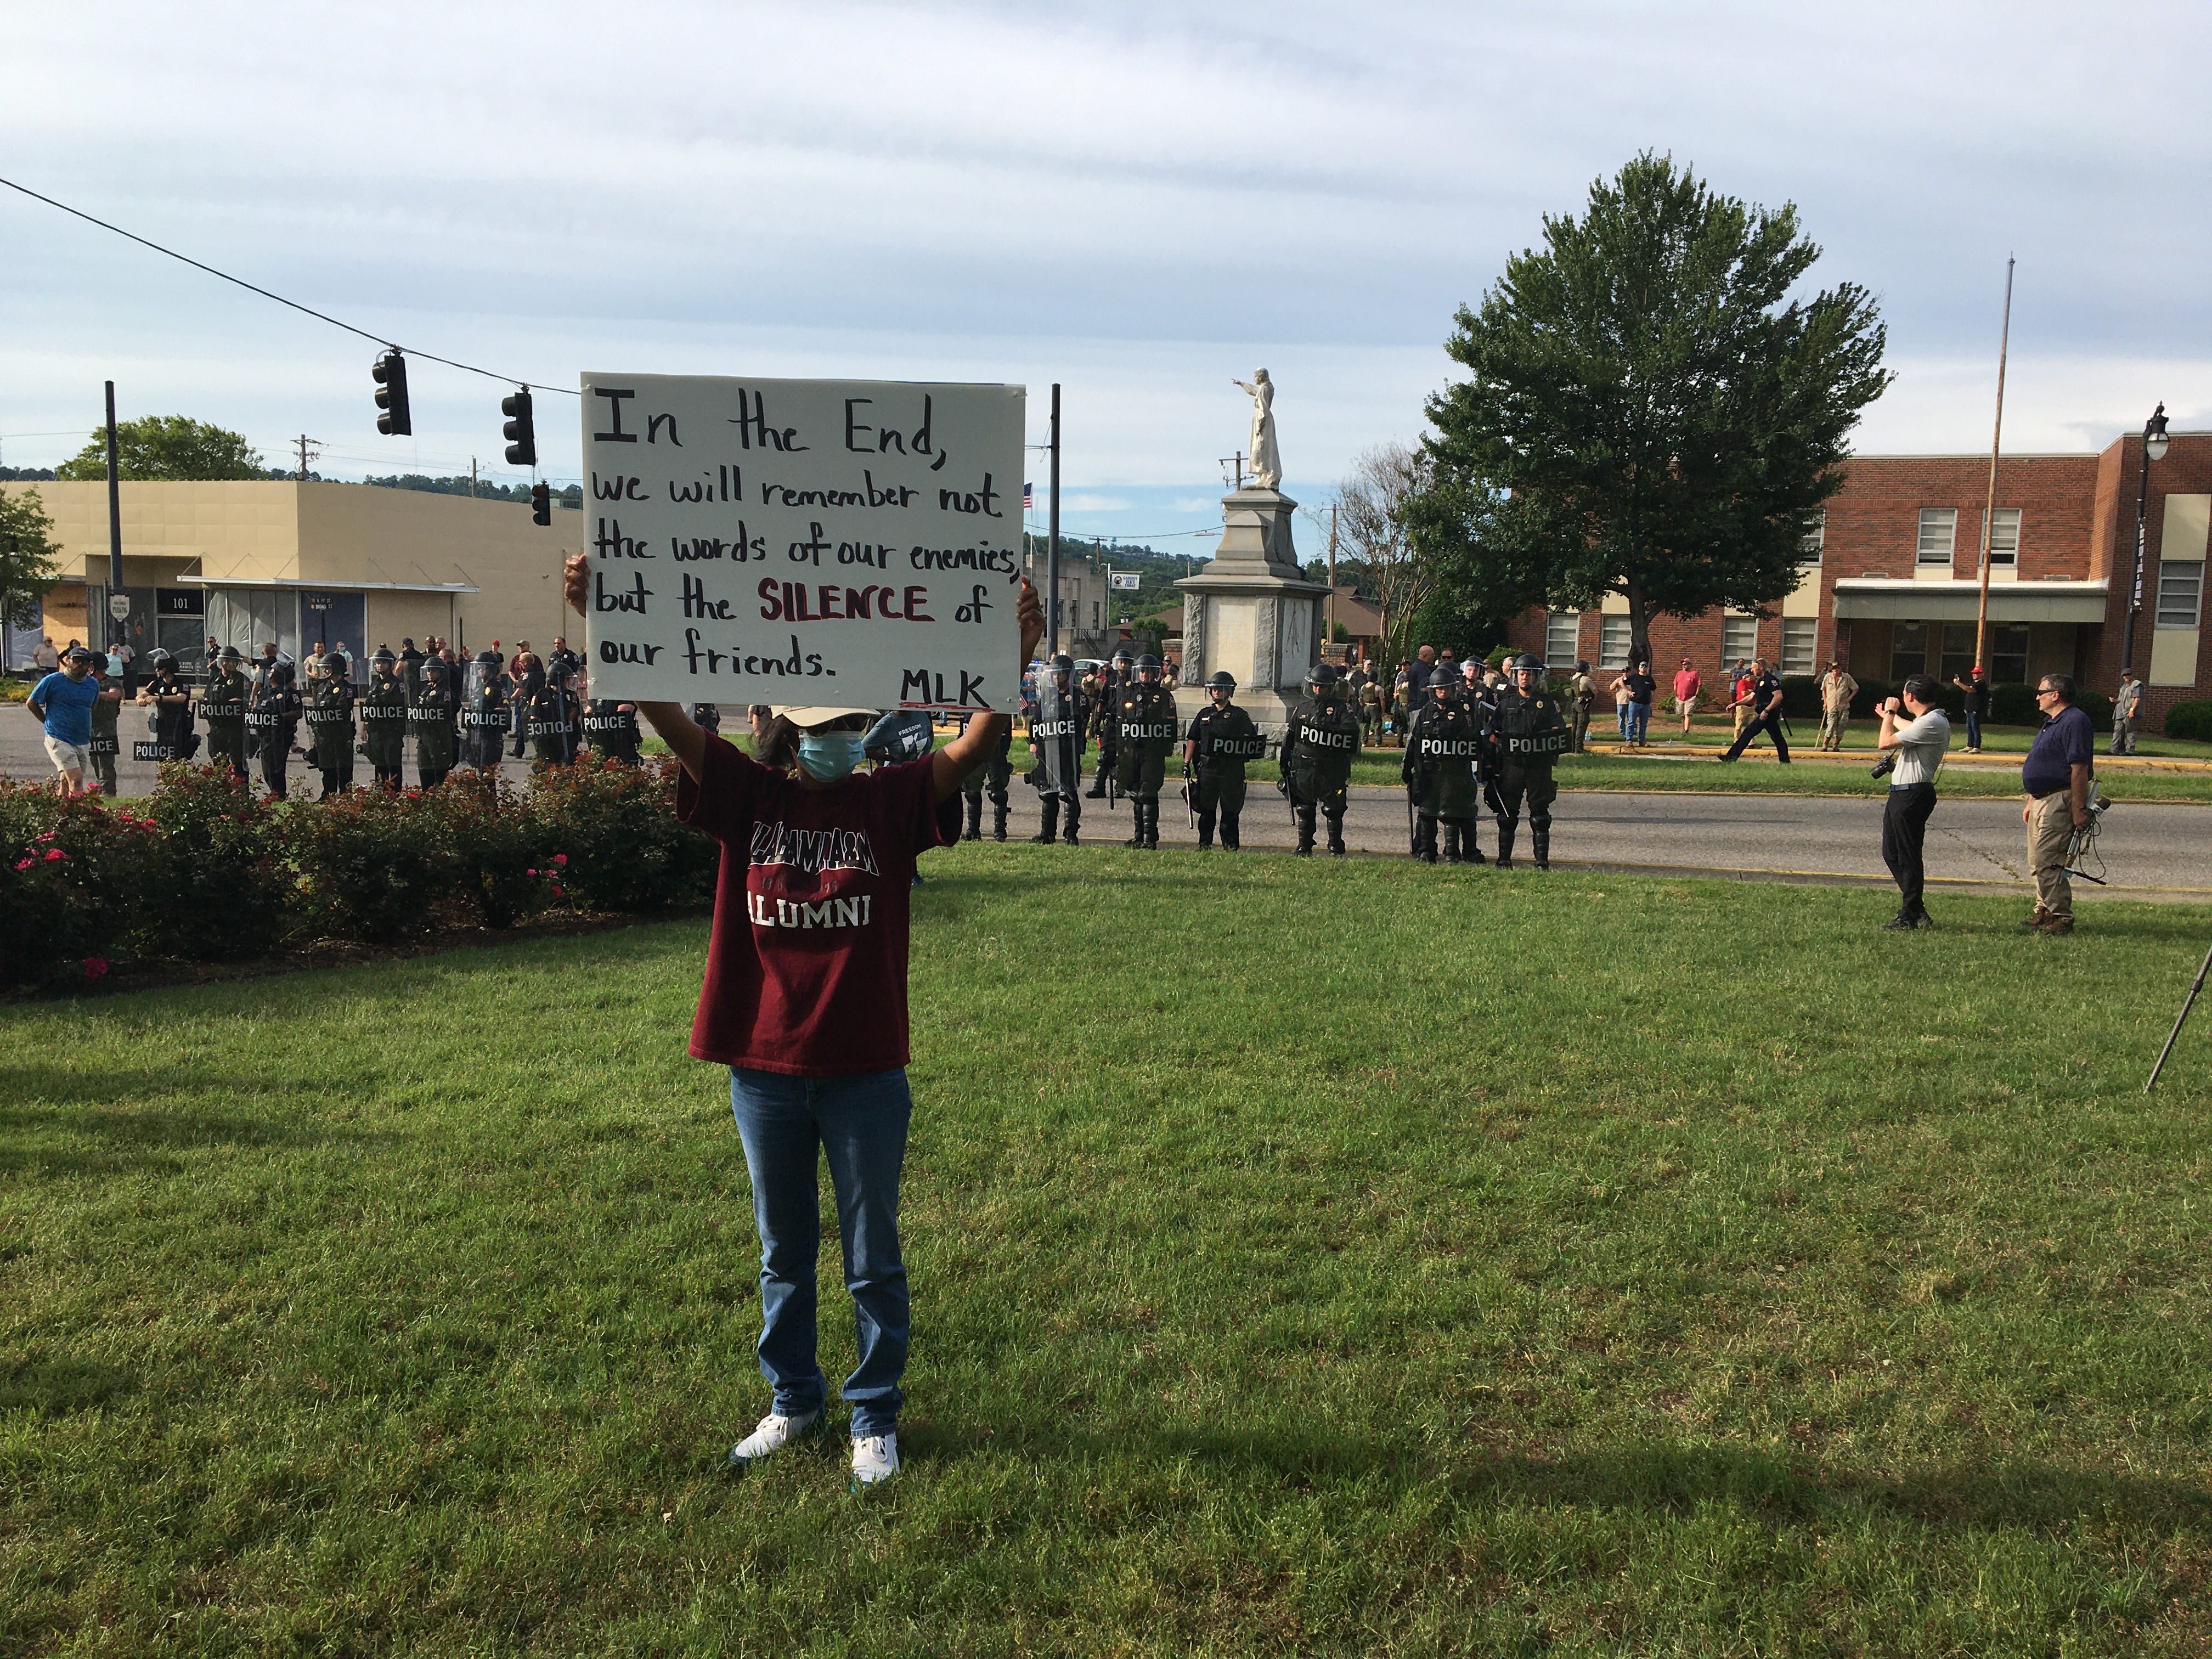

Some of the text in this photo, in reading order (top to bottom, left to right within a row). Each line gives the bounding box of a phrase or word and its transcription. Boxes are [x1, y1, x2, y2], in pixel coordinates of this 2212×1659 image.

[593, 387, 947, 472] In the End,
[592, 464, 1003, 518] we will remember not
[592, 517, 1020, 585] the words of our enemies,
[173, 597, 188, 609] 101
[595, 571, 994, 624] but the SILENCE of
[600, 628, 837, 676] our friends.
[898, 668, 989, 706] MLK
[200, 704, 241, 716] POLICE
[306, 709, 343, 721] POLICE
[363, 706, 404, 718] POLICE
[408, 708, 444, 720] POLICE
[245, 713, 278, 726] POLICE
[464, 712, 506, 726] POLICE
[584, 716, 626, 730] POLICE
[898, 723, 922, 736] FREEDOM
[1032, 720, 1075, 738] POLICE
[1122, 724, 1172, 738] POLICE
[1300, 725, 1352, 749] POLICE
[1510, 735, 1566, 753] POLICE
[136, 746, 174, 757] POLICE
[1214, 738, 1262, 754] POLICE
[1421, 739, 1477, 755] POLICE
